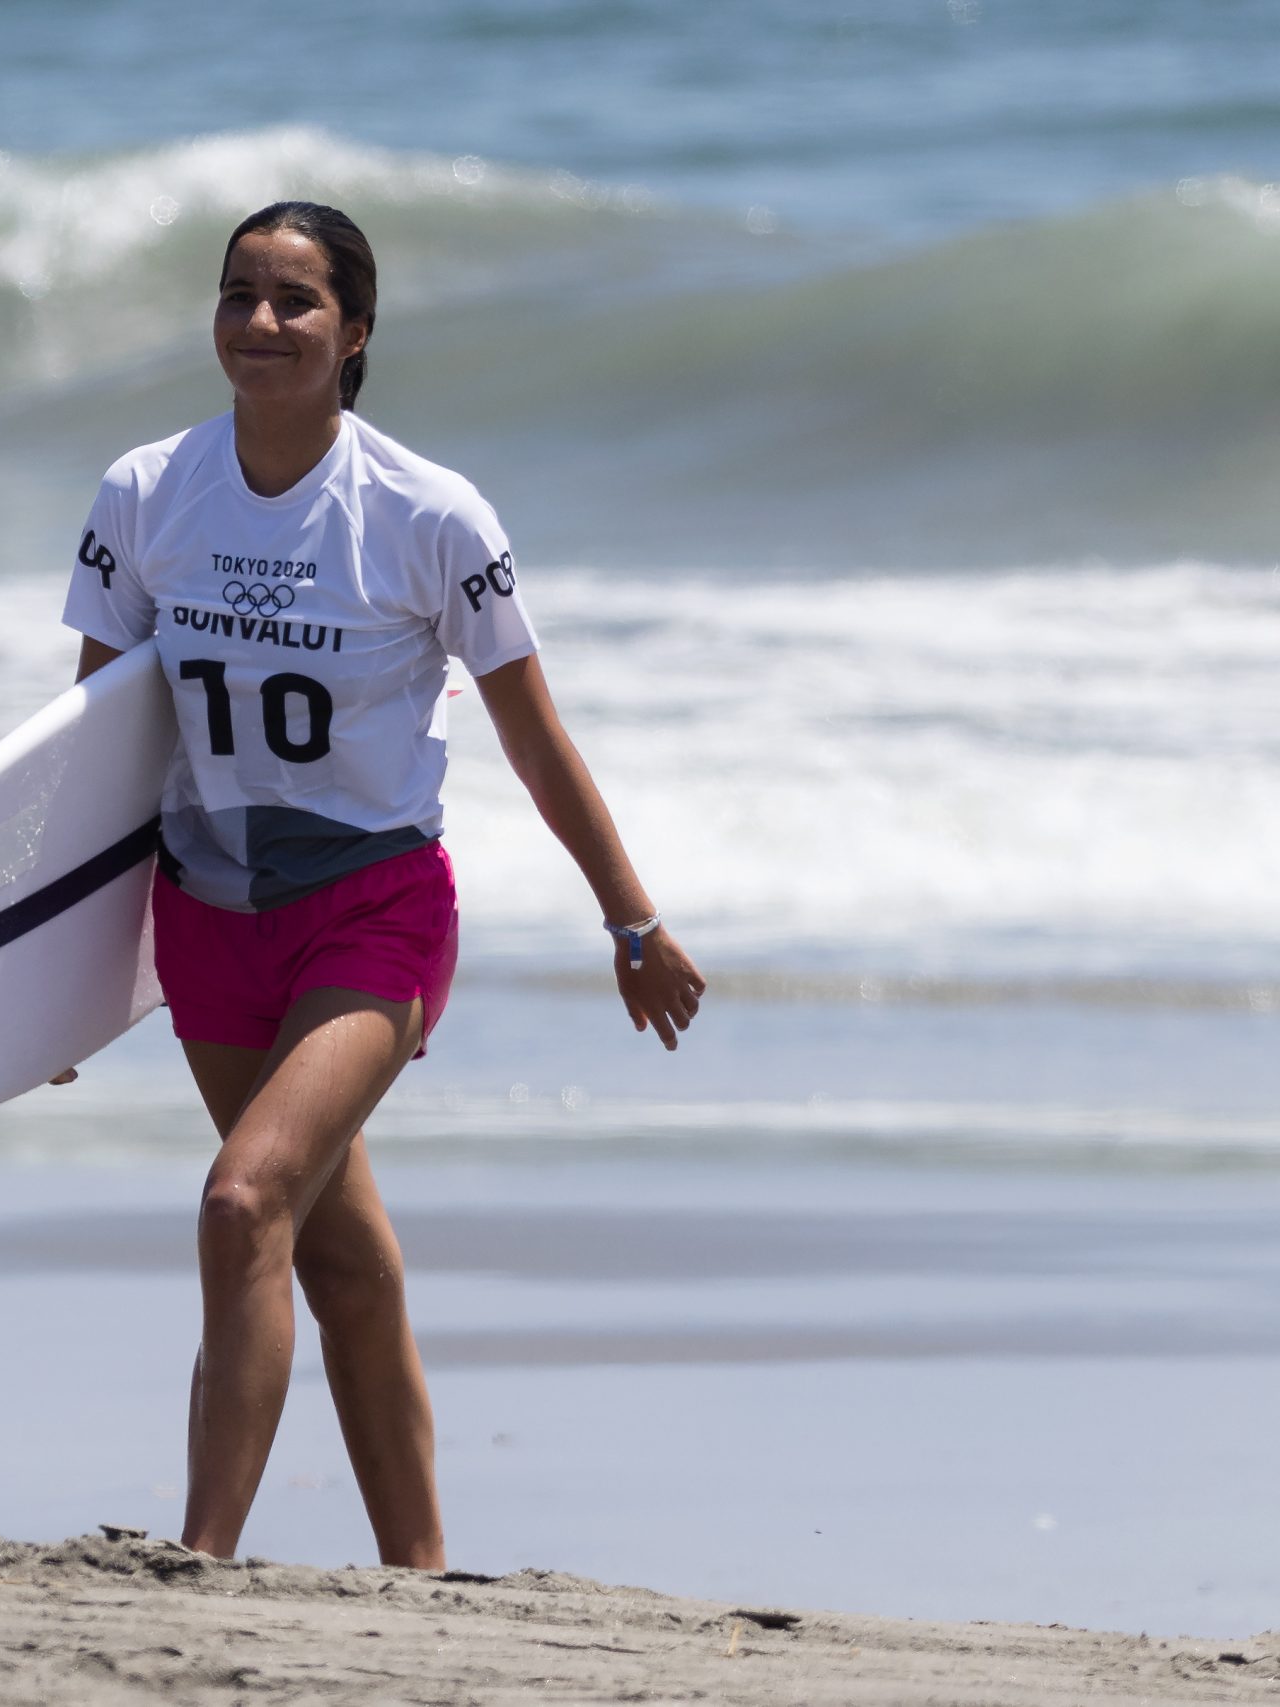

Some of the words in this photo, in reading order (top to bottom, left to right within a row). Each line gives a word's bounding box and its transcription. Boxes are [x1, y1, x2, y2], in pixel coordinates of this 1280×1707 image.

[78, 529, 116, 590] OR
[211, 554, 269, 576] TOKYO
[271, 560, 317, 579] 2020
[460, 550, 516, 613] POR
[179, 659, 333, 764] 10
